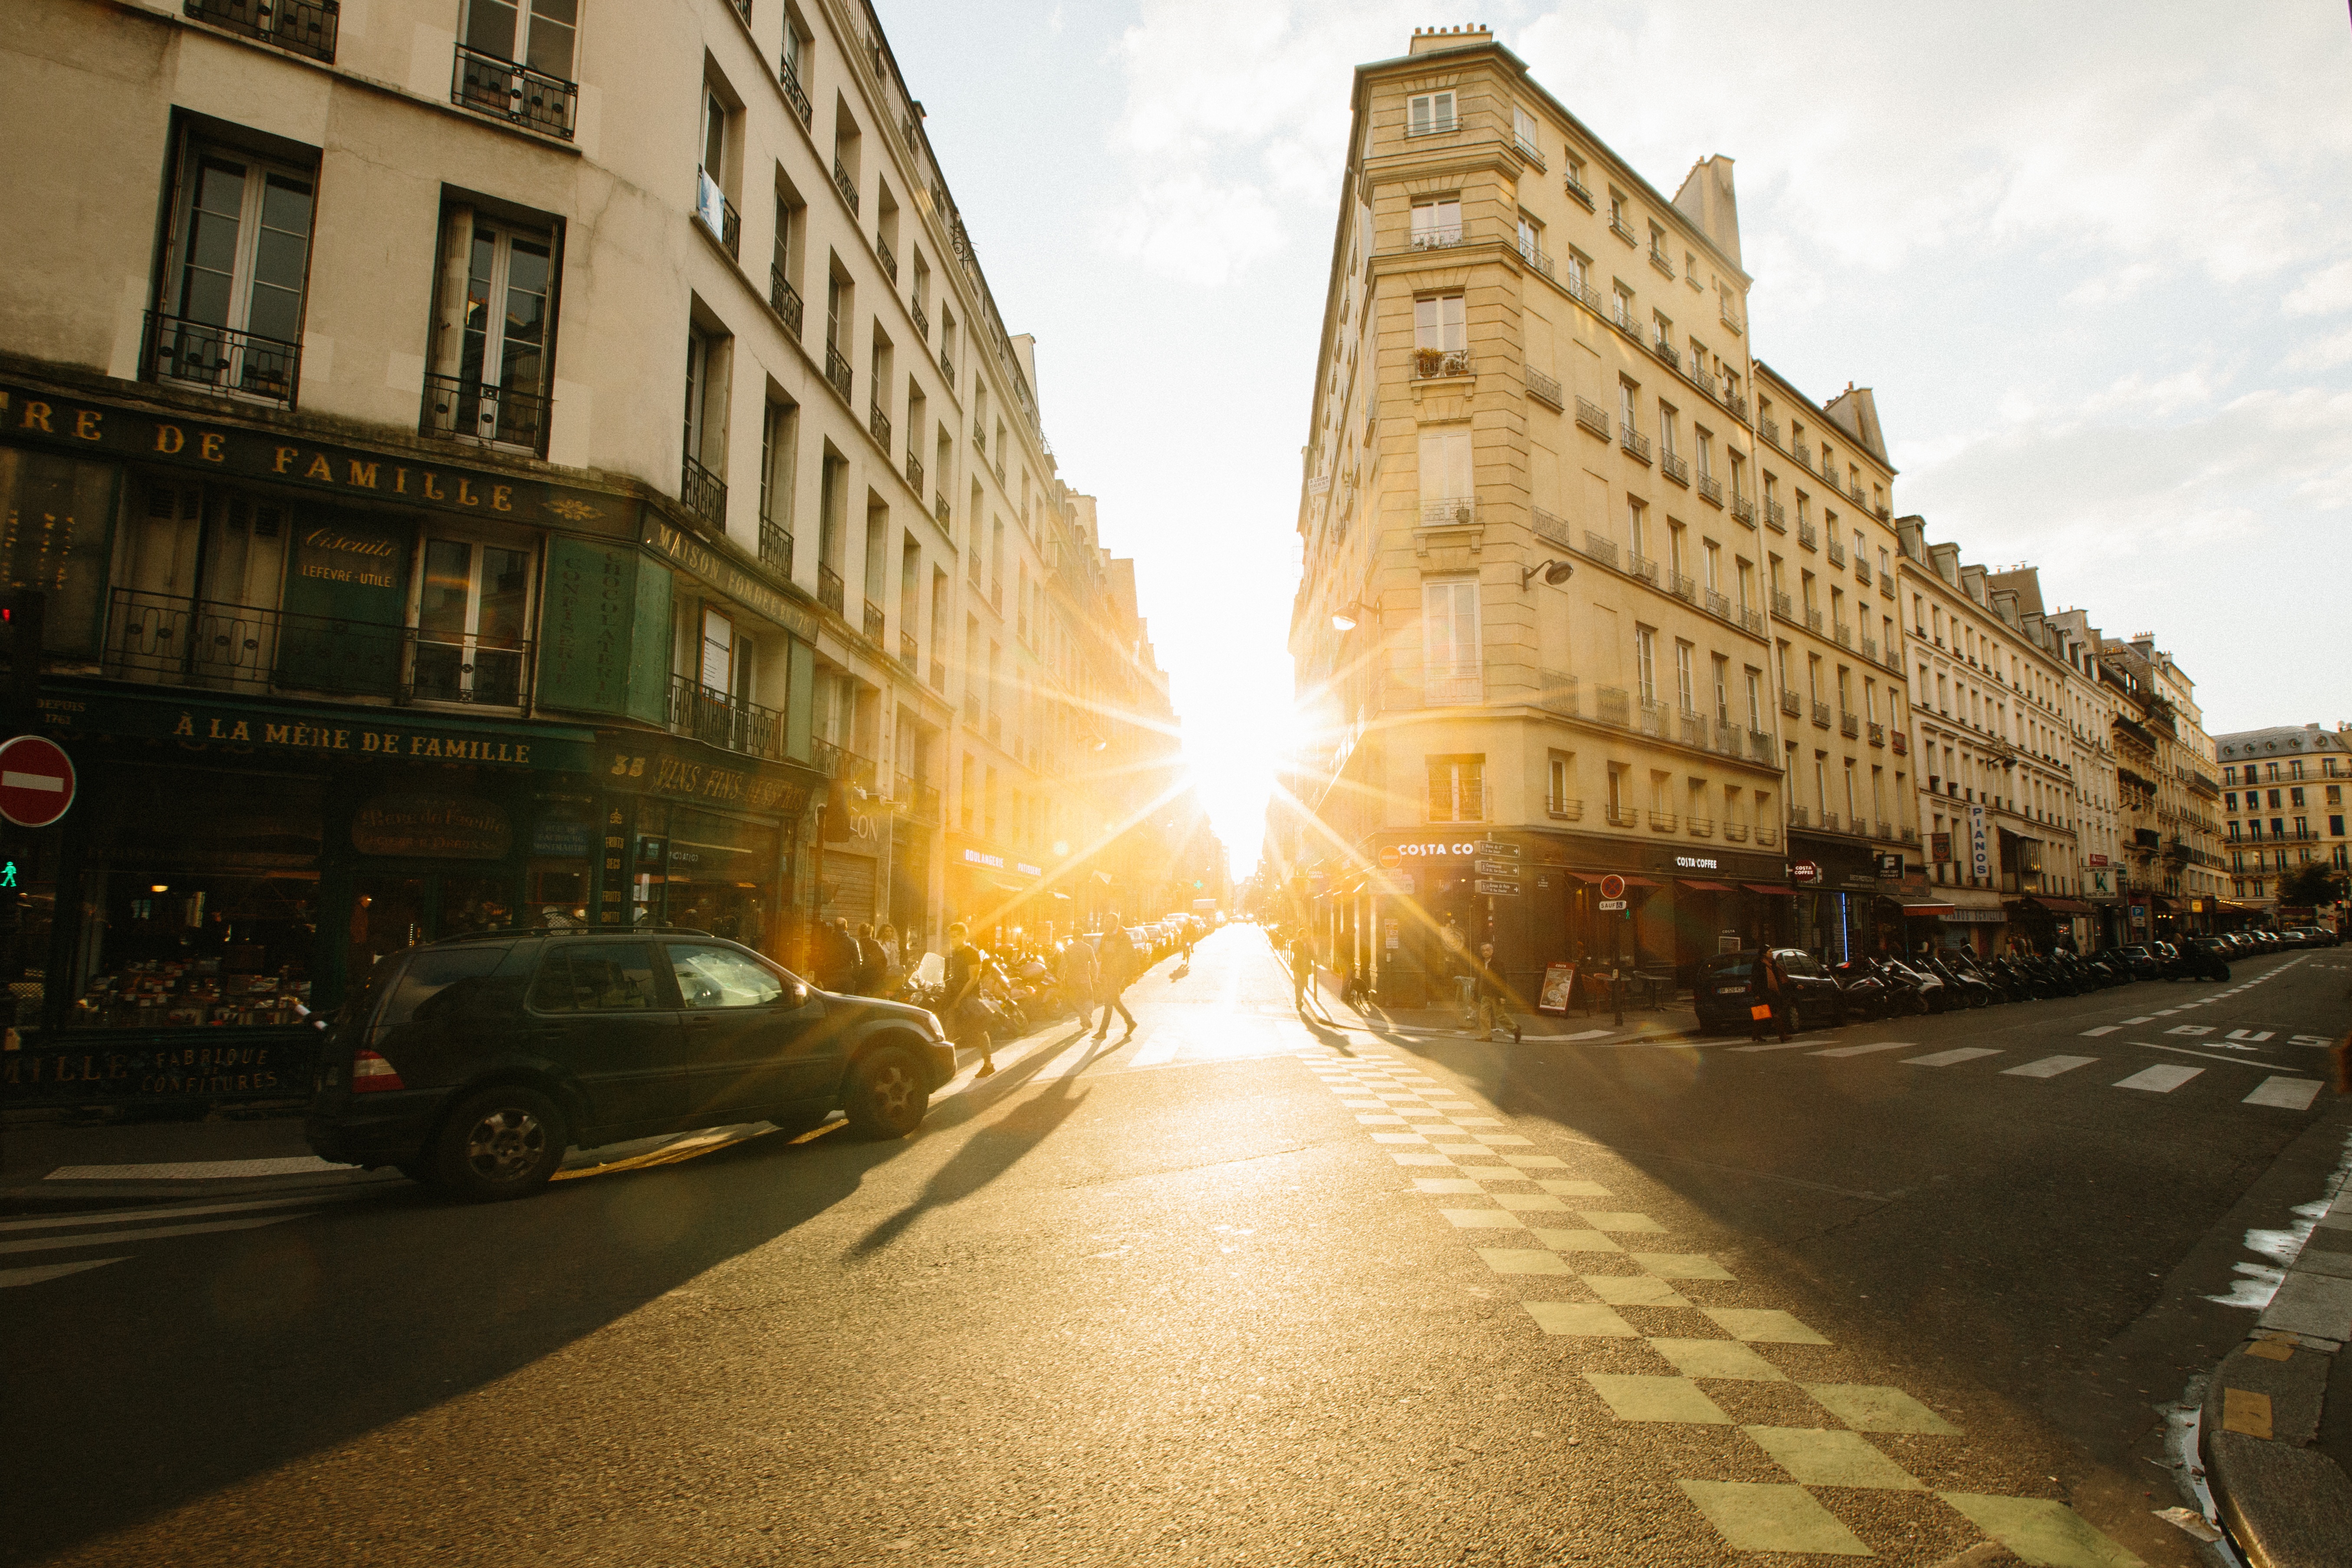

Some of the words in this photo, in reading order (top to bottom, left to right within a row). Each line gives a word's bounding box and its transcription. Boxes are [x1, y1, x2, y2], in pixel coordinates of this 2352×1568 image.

[152, 424, 226, 463] DE
[271, 445, 513, 513] FAMILLE
[658, 523, 721, 580] MAISON
[36, 698, 86, 712] DEPUIS
[45, 713, 72, 725] 1761
[172, 710, 195, 736] À
[208, 718, 251, 741] LA
[264, 722, 351, 749] MÈRE
[361, 732, 401, 754] DE
[409, 736, 530, 763] FAMILLE
[656, 757, 702, 792] VINS
[703, 770, 743, 799] FINS
[744, 779, 806, 810] DESSERTS
[1398, 844, 1447, 857] COSTA
[1452, 843, 1474, 855] CO
[1972, 808, 1987, 874] PIANOS
[606, 858, 621, 869] SECS
[965, 848, 1004, 868] BOULANGERIE
[1018, 862, 1042, 877] PATISSERIE
[1677, 856, 1695, 868] COSTA
[1697, 858, 1717, 869] COFFEE
[1884, 857, 1895, 868] F
[2094, 872, 2108, 892] K
[2162, 1024, 2335, 1048] BUS
[155, 1048, 269, 1068] FABRIQUE
[141, 1071, 278, 1094] CONFITURES
